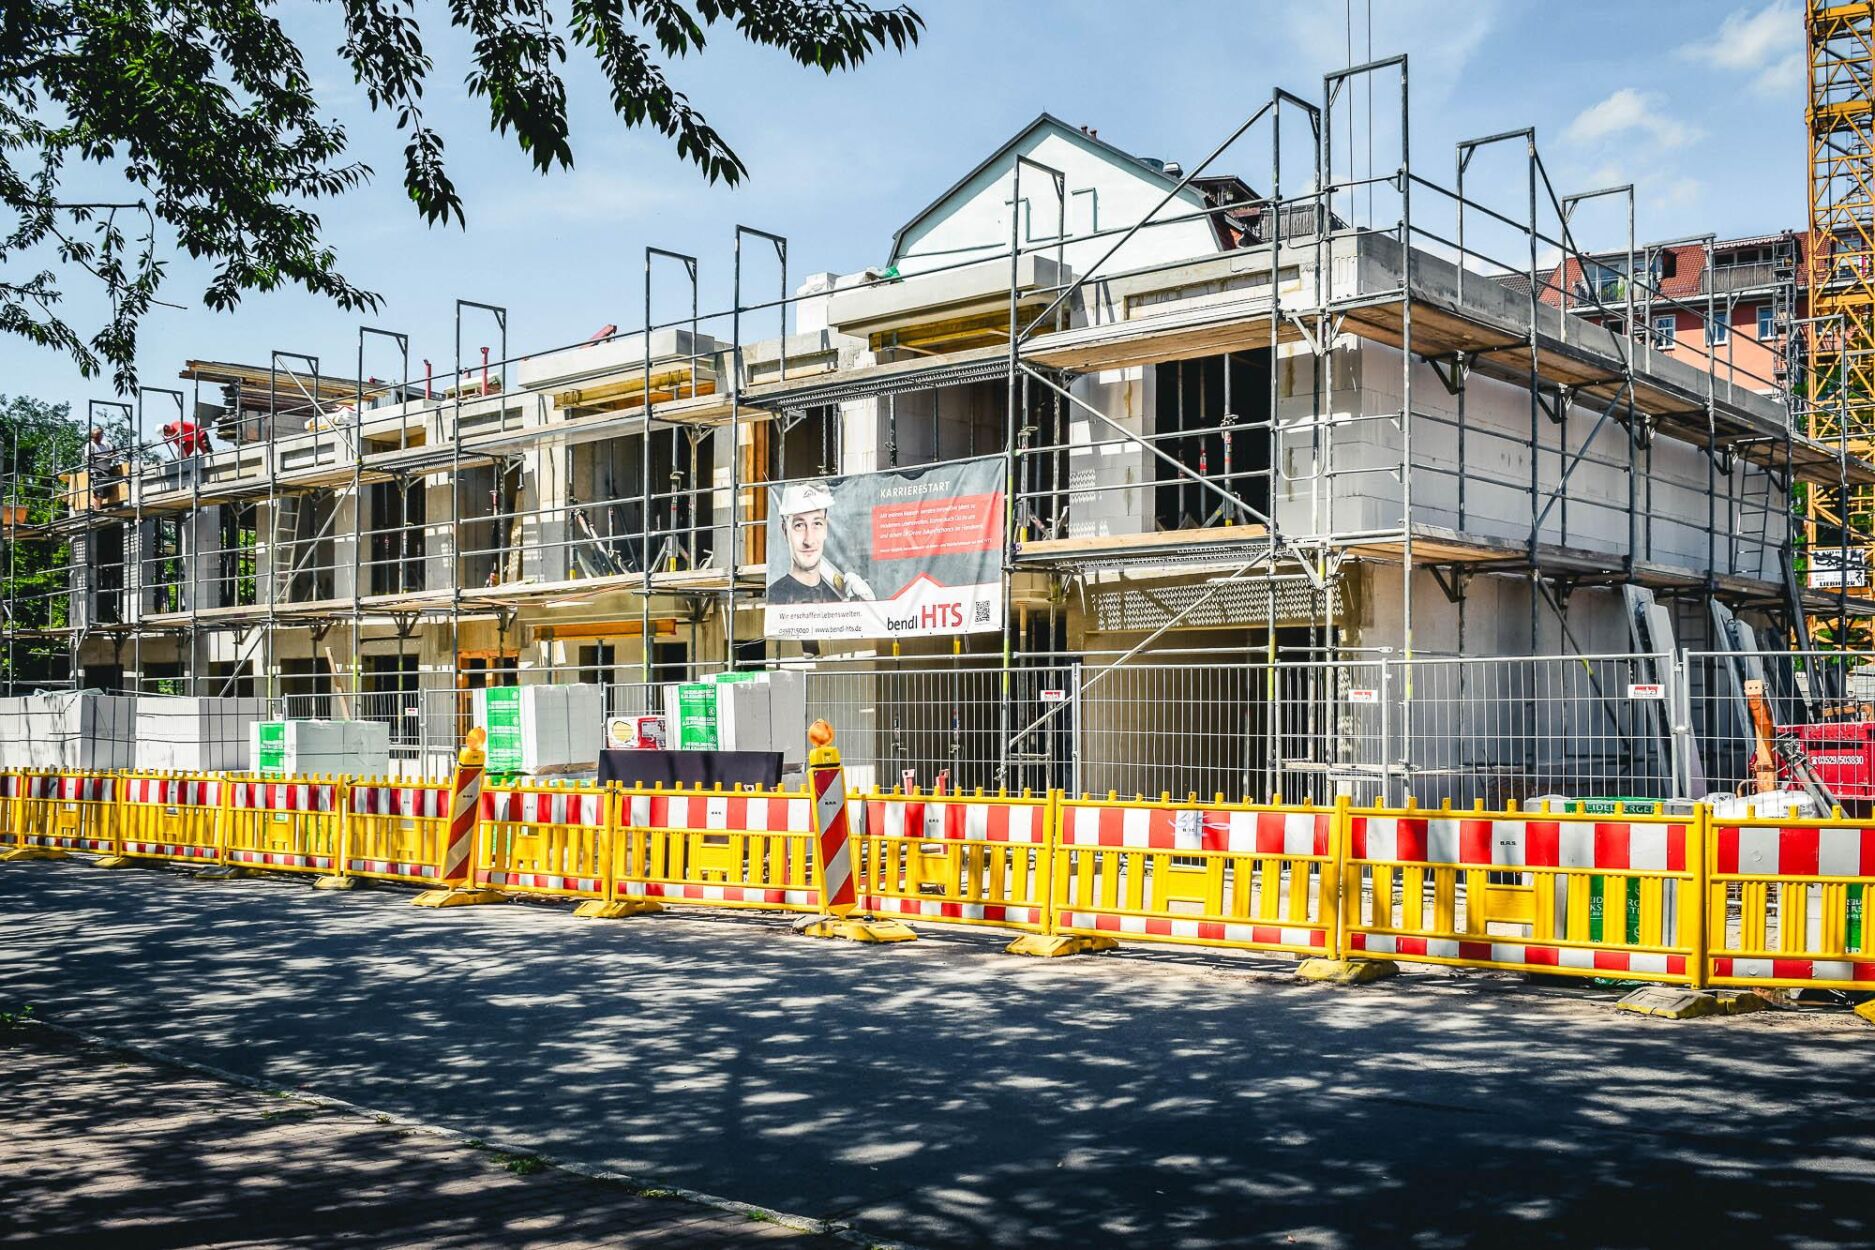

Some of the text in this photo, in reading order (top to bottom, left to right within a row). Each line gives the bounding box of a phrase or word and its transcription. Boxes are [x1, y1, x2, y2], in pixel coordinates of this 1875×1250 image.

[880, 481, 950, 499] KARRIERESTART
[887, 603, 963, 630] bendl HTS
